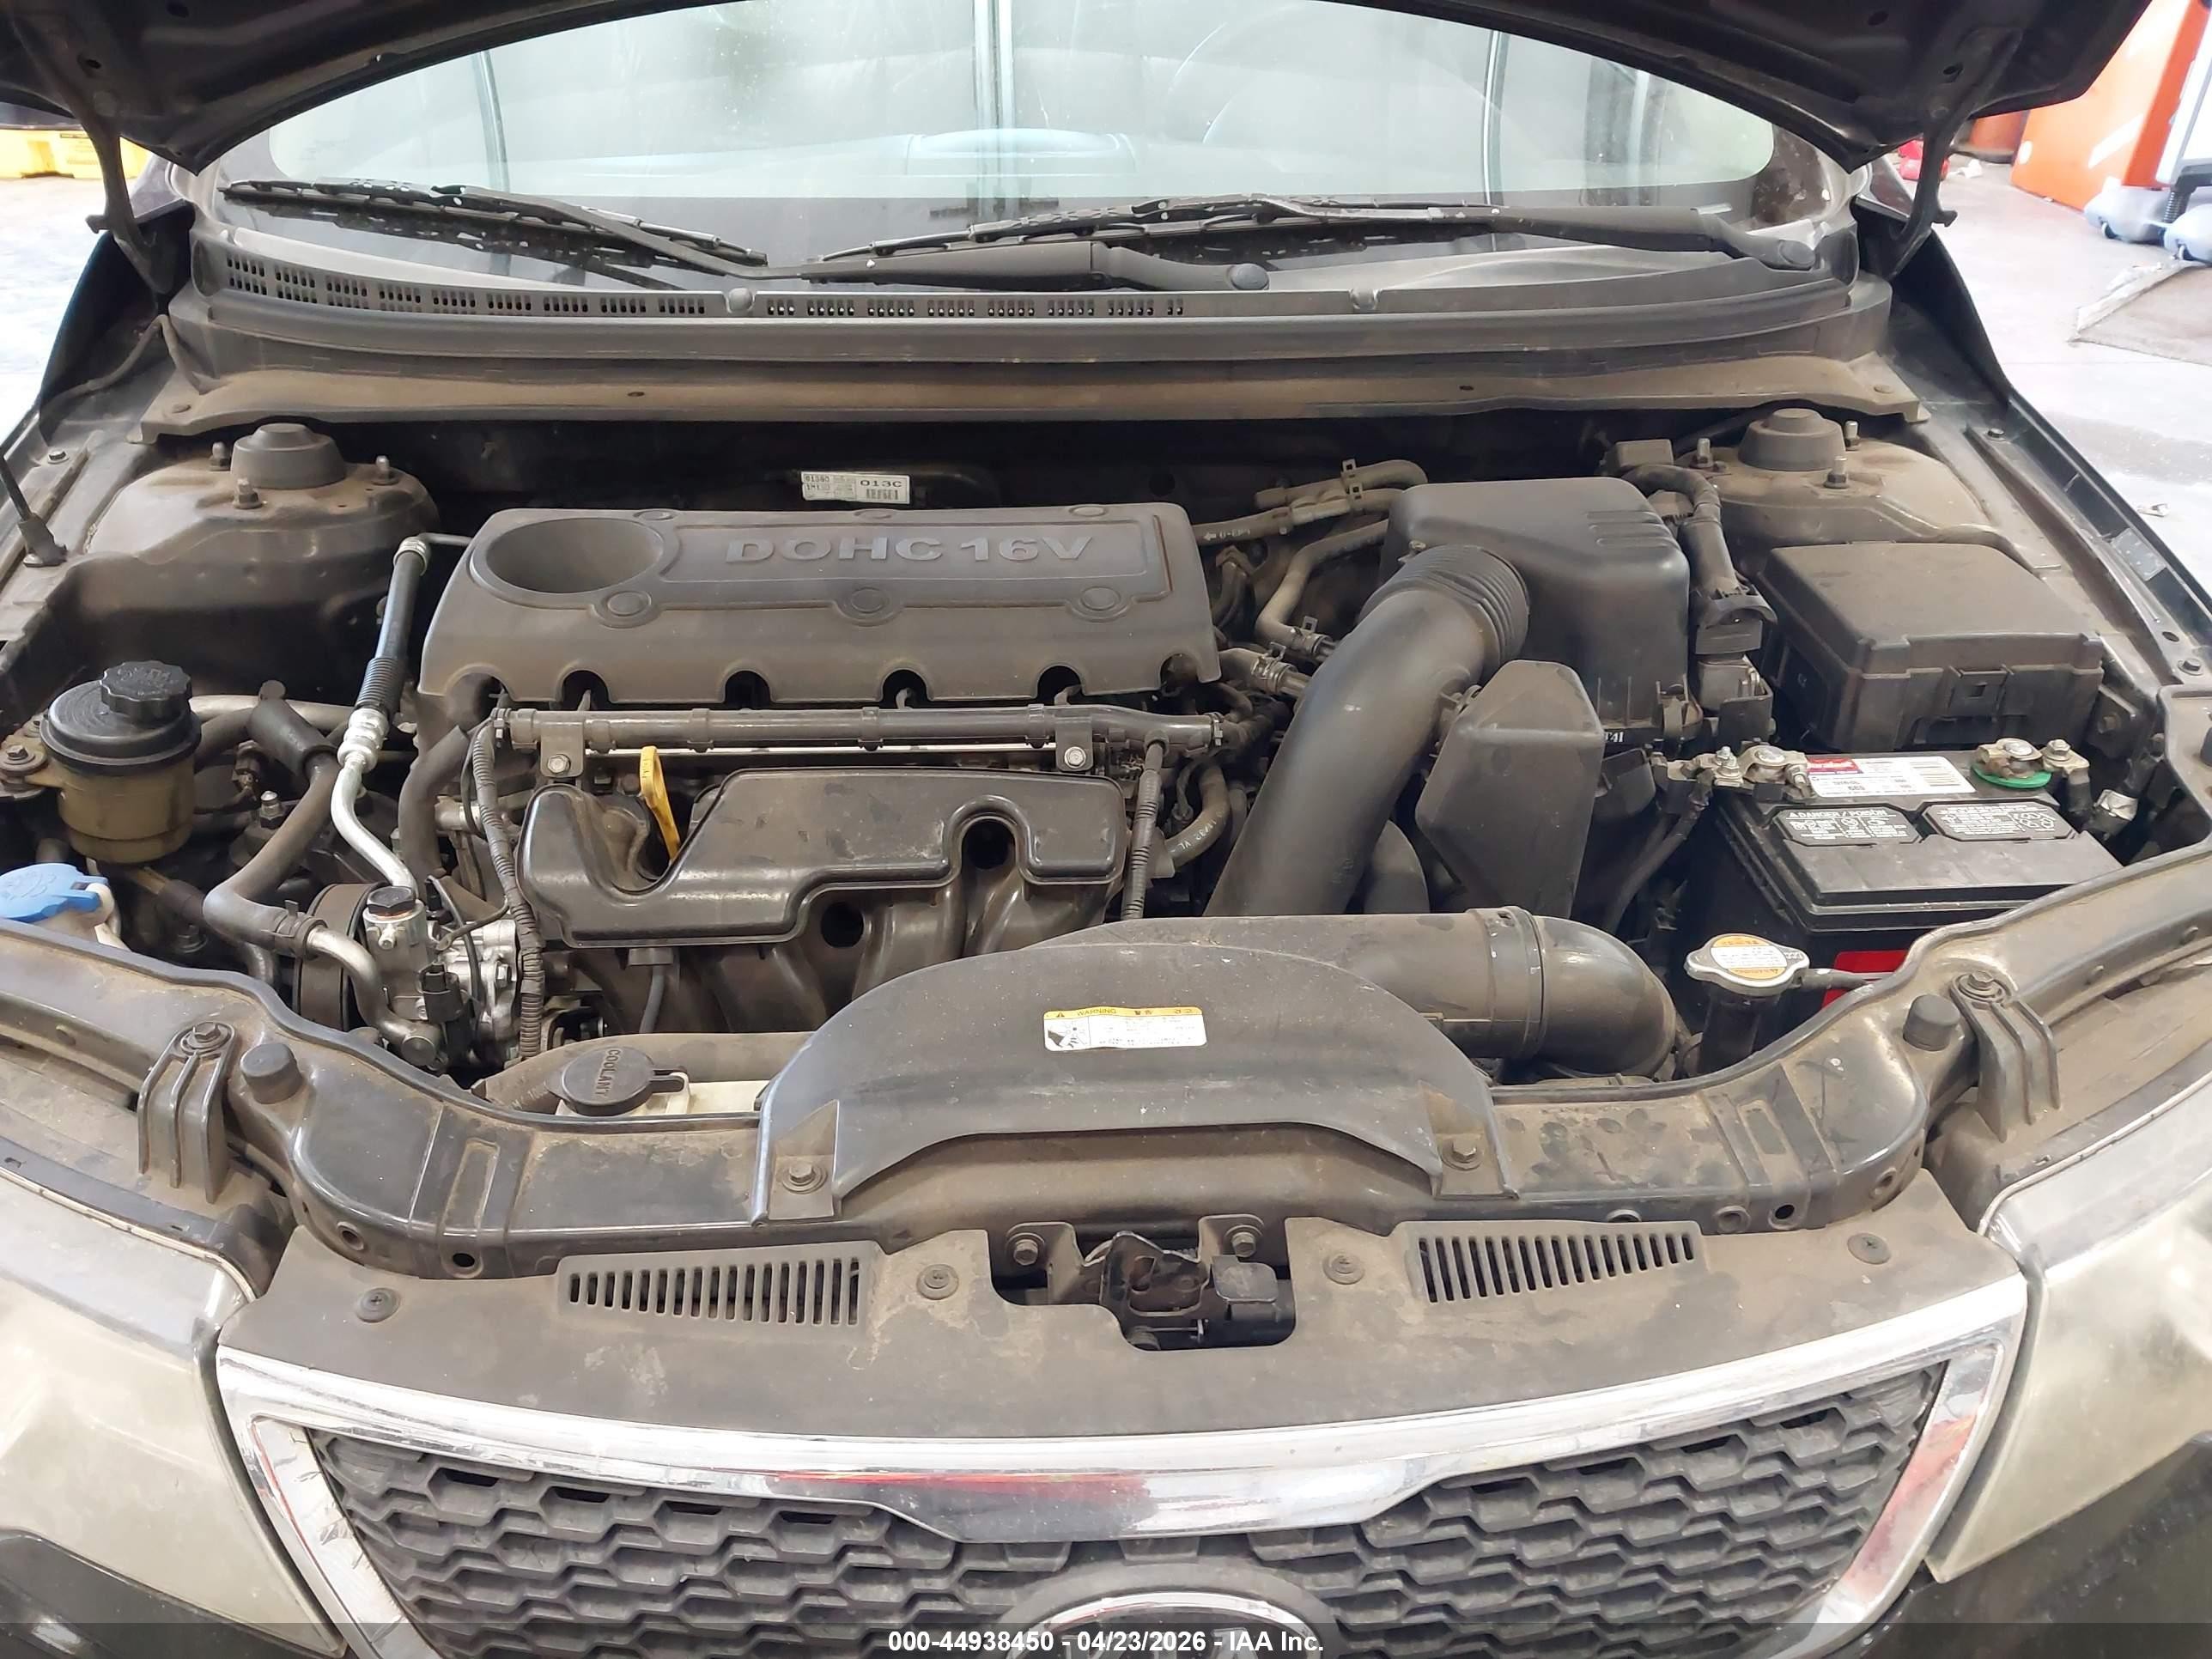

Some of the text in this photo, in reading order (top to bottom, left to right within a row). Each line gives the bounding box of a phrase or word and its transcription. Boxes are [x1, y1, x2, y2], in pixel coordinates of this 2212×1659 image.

[725, 536, 1093, 563] DOHC 16V
[594, 1048, 621, 1097] COOLANT
